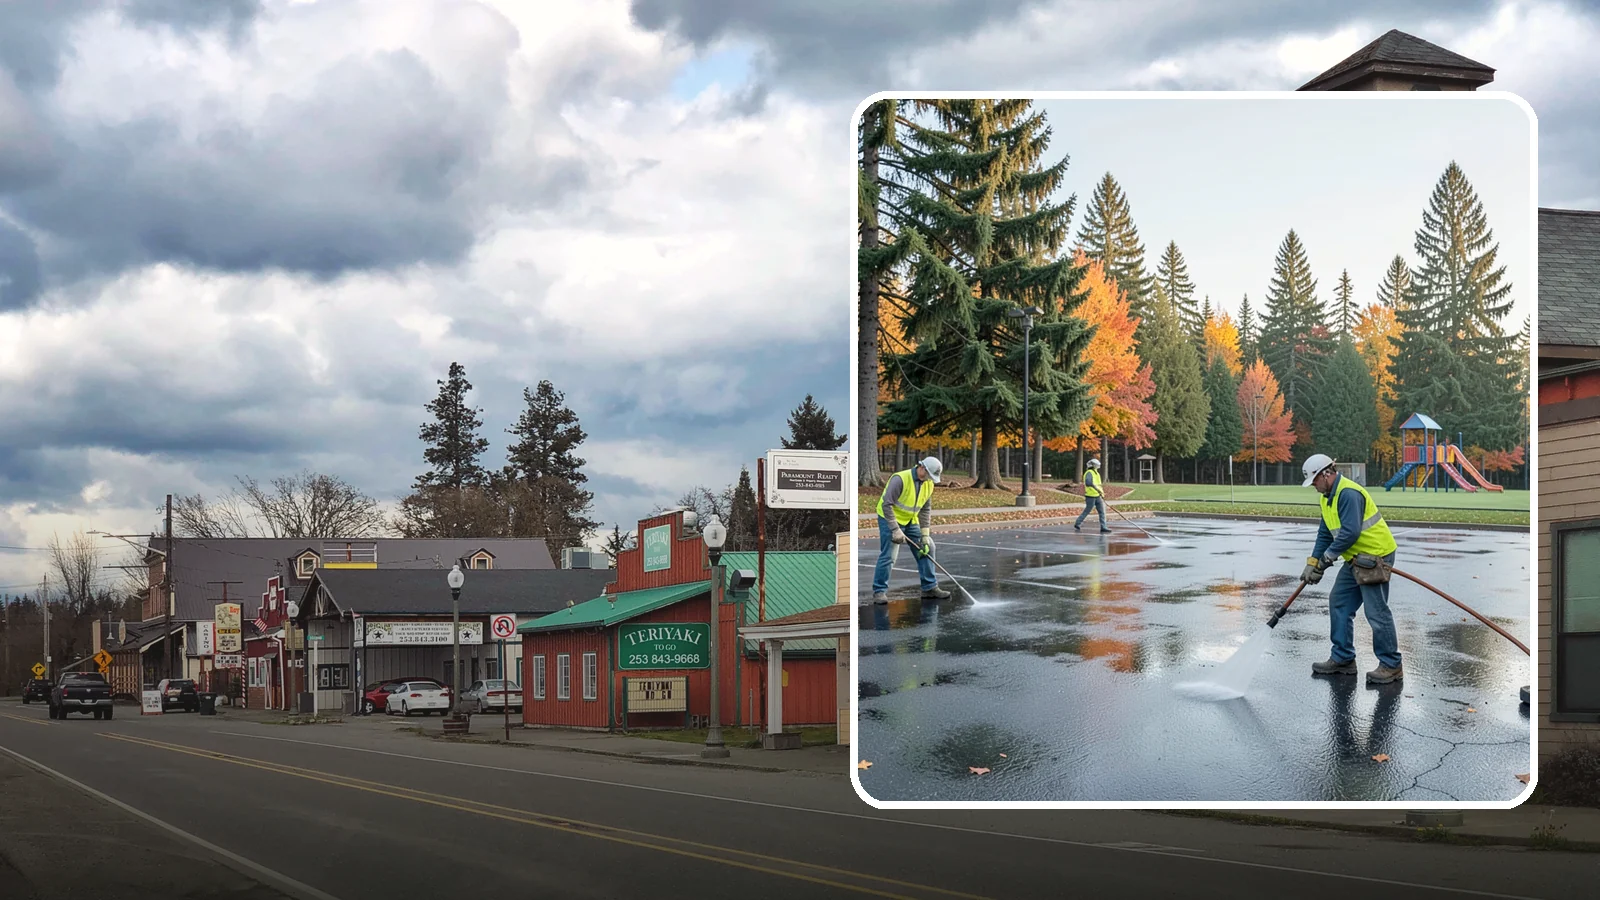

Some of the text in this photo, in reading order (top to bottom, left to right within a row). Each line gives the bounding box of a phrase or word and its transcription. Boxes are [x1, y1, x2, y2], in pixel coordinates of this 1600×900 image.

[625, 627, 703, 646] TERIYAKI
[628, 654, 700, 664] 253 843-9668
